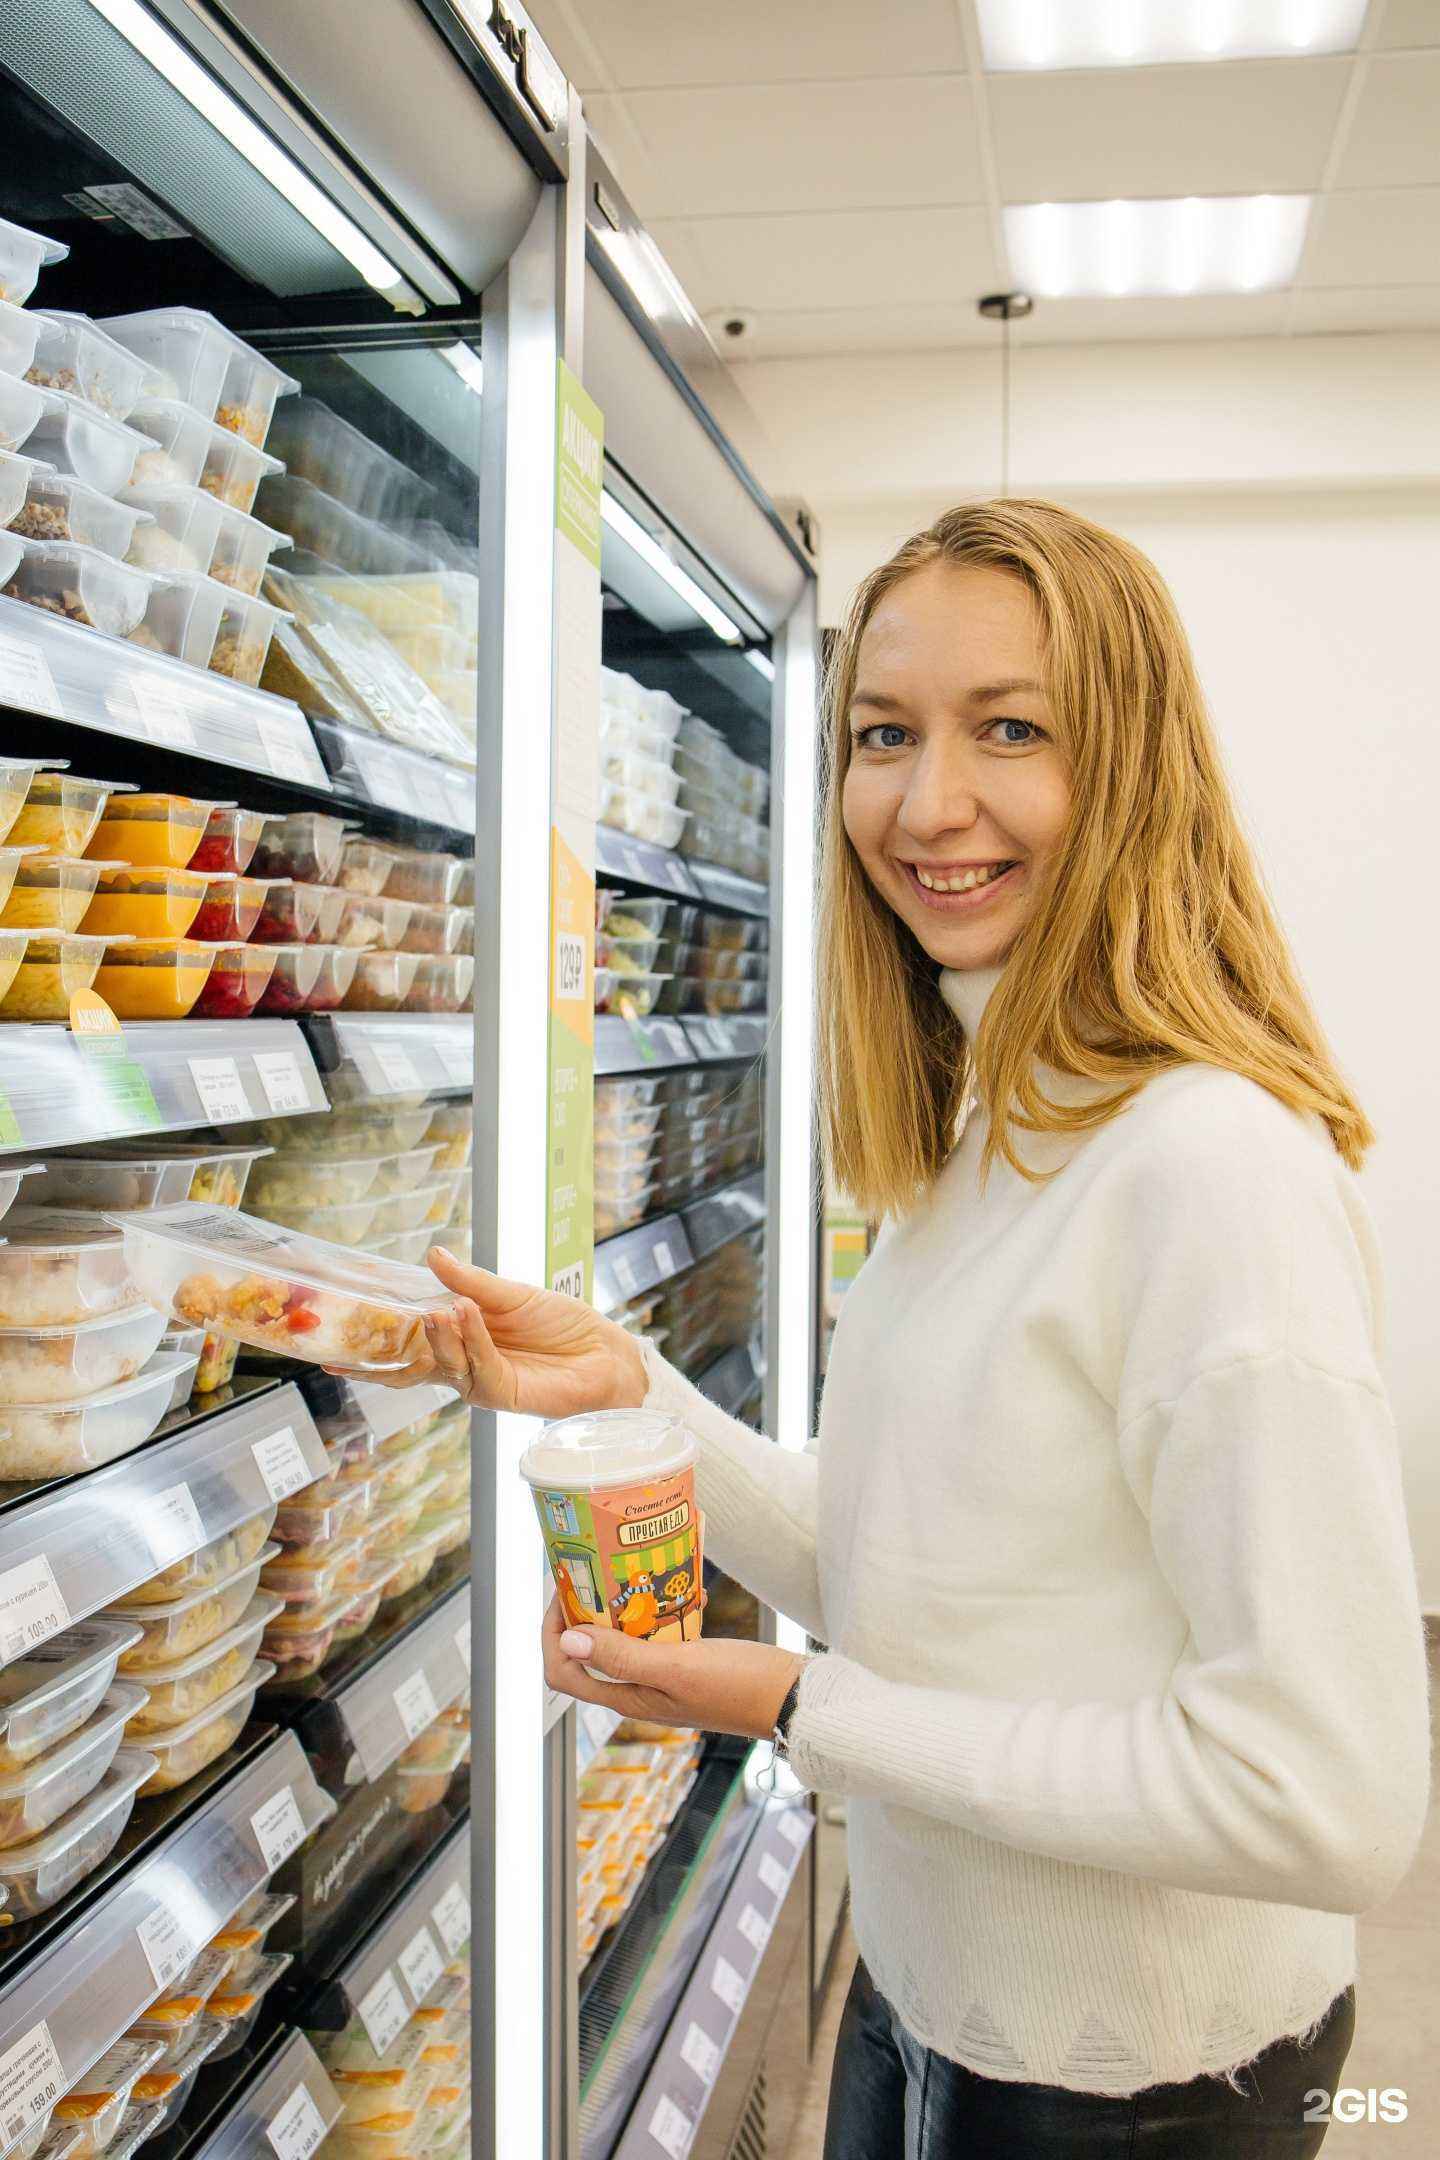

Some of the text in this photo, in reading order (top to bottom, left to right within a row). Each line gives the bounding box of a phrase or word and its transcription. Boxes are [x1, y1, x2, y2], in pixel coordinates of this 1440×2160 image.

[563, 401, 600, 487] АКЦИЯ
[625, 1485, 684, 1516] Счастье есть!
[629, 1508, 684, 1542] ПРОСТАЯ ЕДА
[30, 2081, 56, 2114] 159.00
